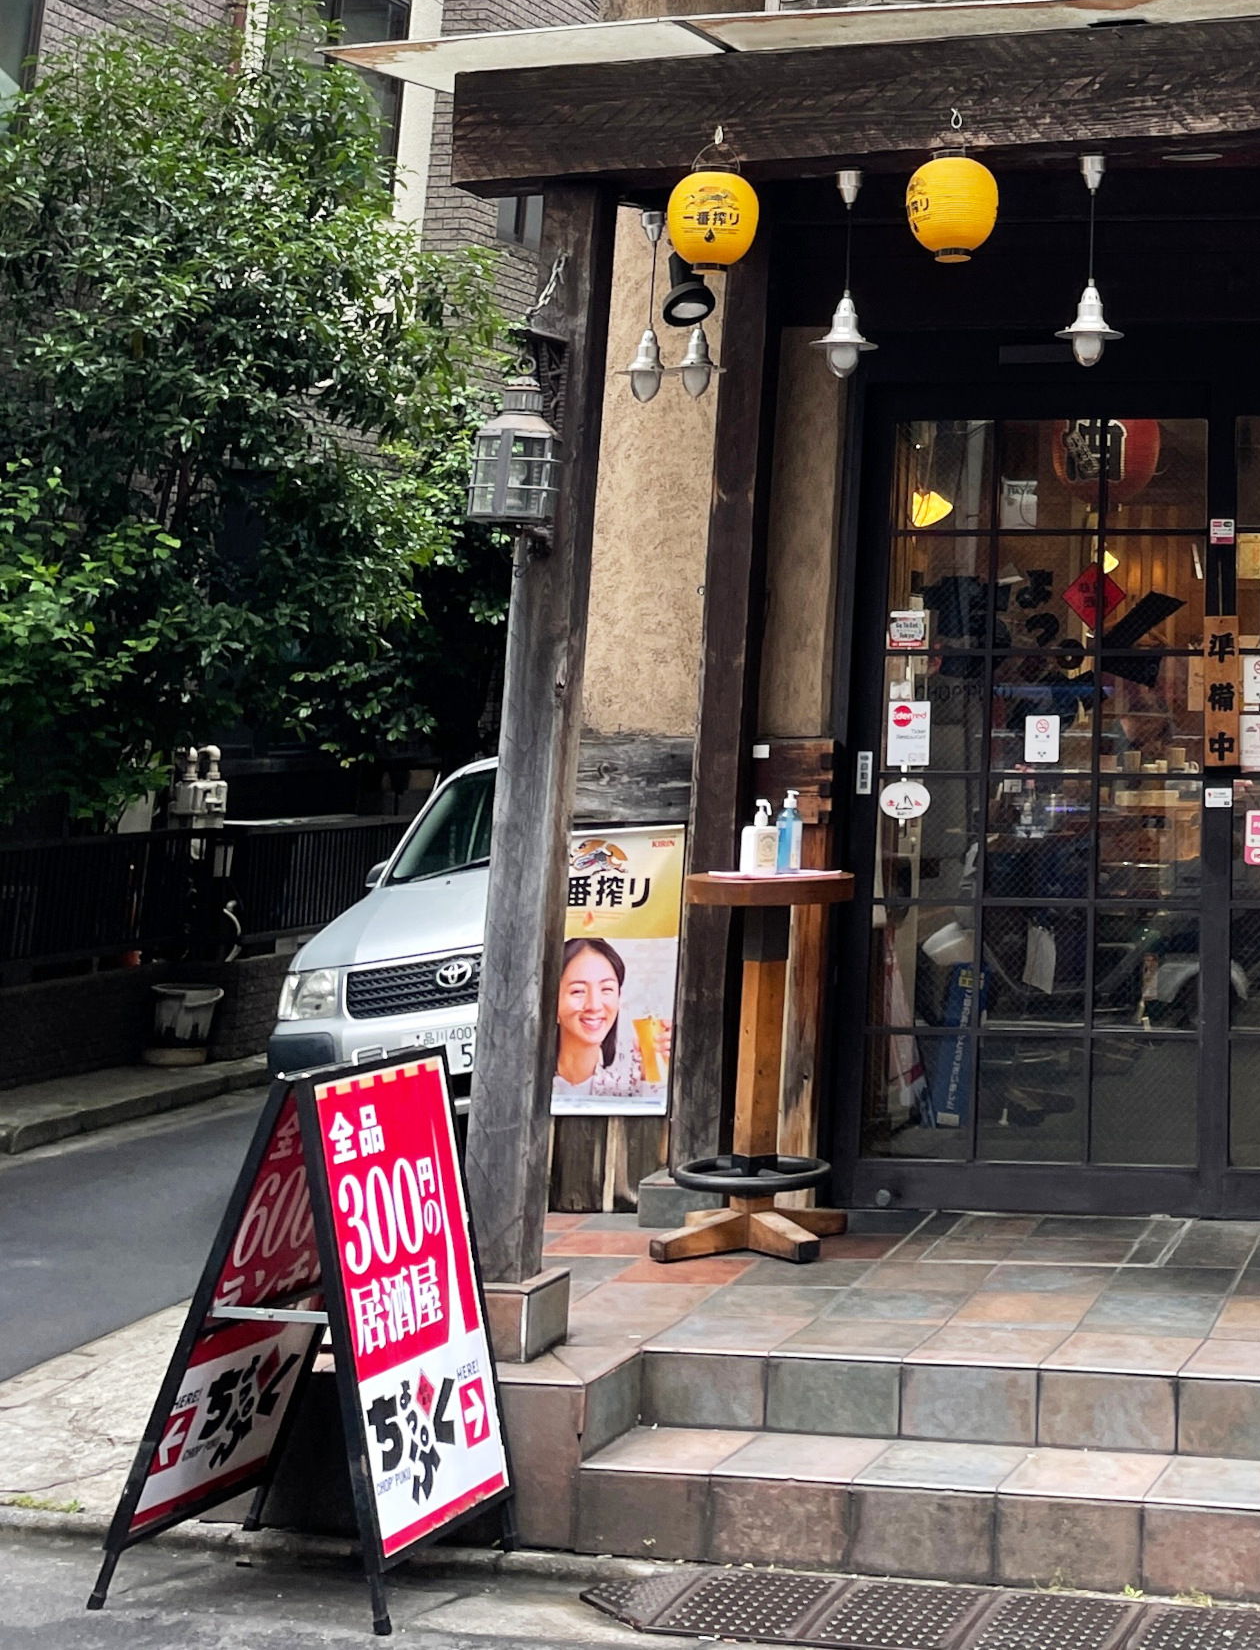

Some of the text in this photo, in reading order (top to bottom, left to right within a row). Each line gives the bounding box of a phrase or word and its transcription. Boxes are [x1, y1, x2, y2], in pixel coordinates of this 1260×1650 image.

[682, 211, 741, 227] 一番搾り
[1208, 631, 1235, 762] 準備中
[892, 710, 927, 721] Edenred
[651, 839, 677, 849] KIRIN
[423, 1026, 473, 1046] 品川 400
[327, 1104, 387, 1165] 全品
[350, 1256, 444, 1359] 居酒屋
[456, 1358, 480, 1382] HERE!
